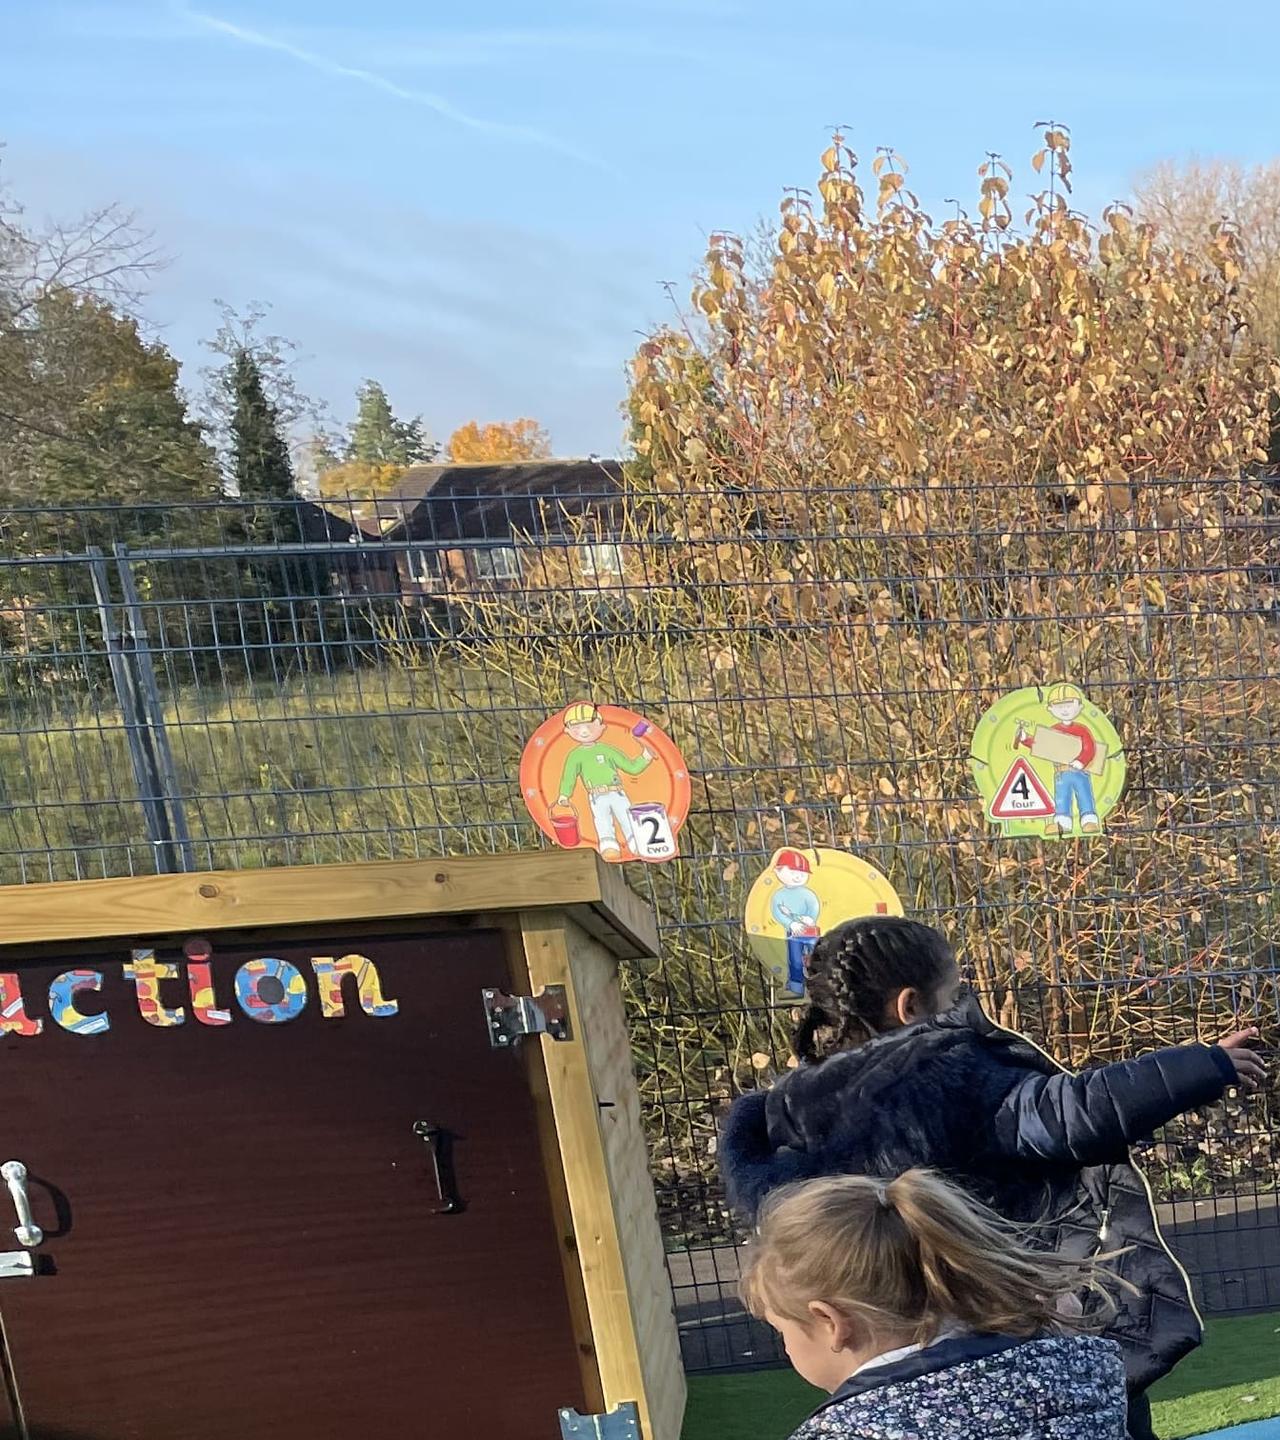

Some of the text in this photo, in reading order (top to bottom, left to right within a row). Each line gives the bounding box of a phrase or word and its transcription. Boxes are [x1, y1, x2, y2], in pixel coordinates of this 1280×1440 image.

[1011, 773, 1030, 800] 4
[1011, 800, 1035, 809] four
[641, 816, 666, 845] 2
[647, 845, 670, 855] two
